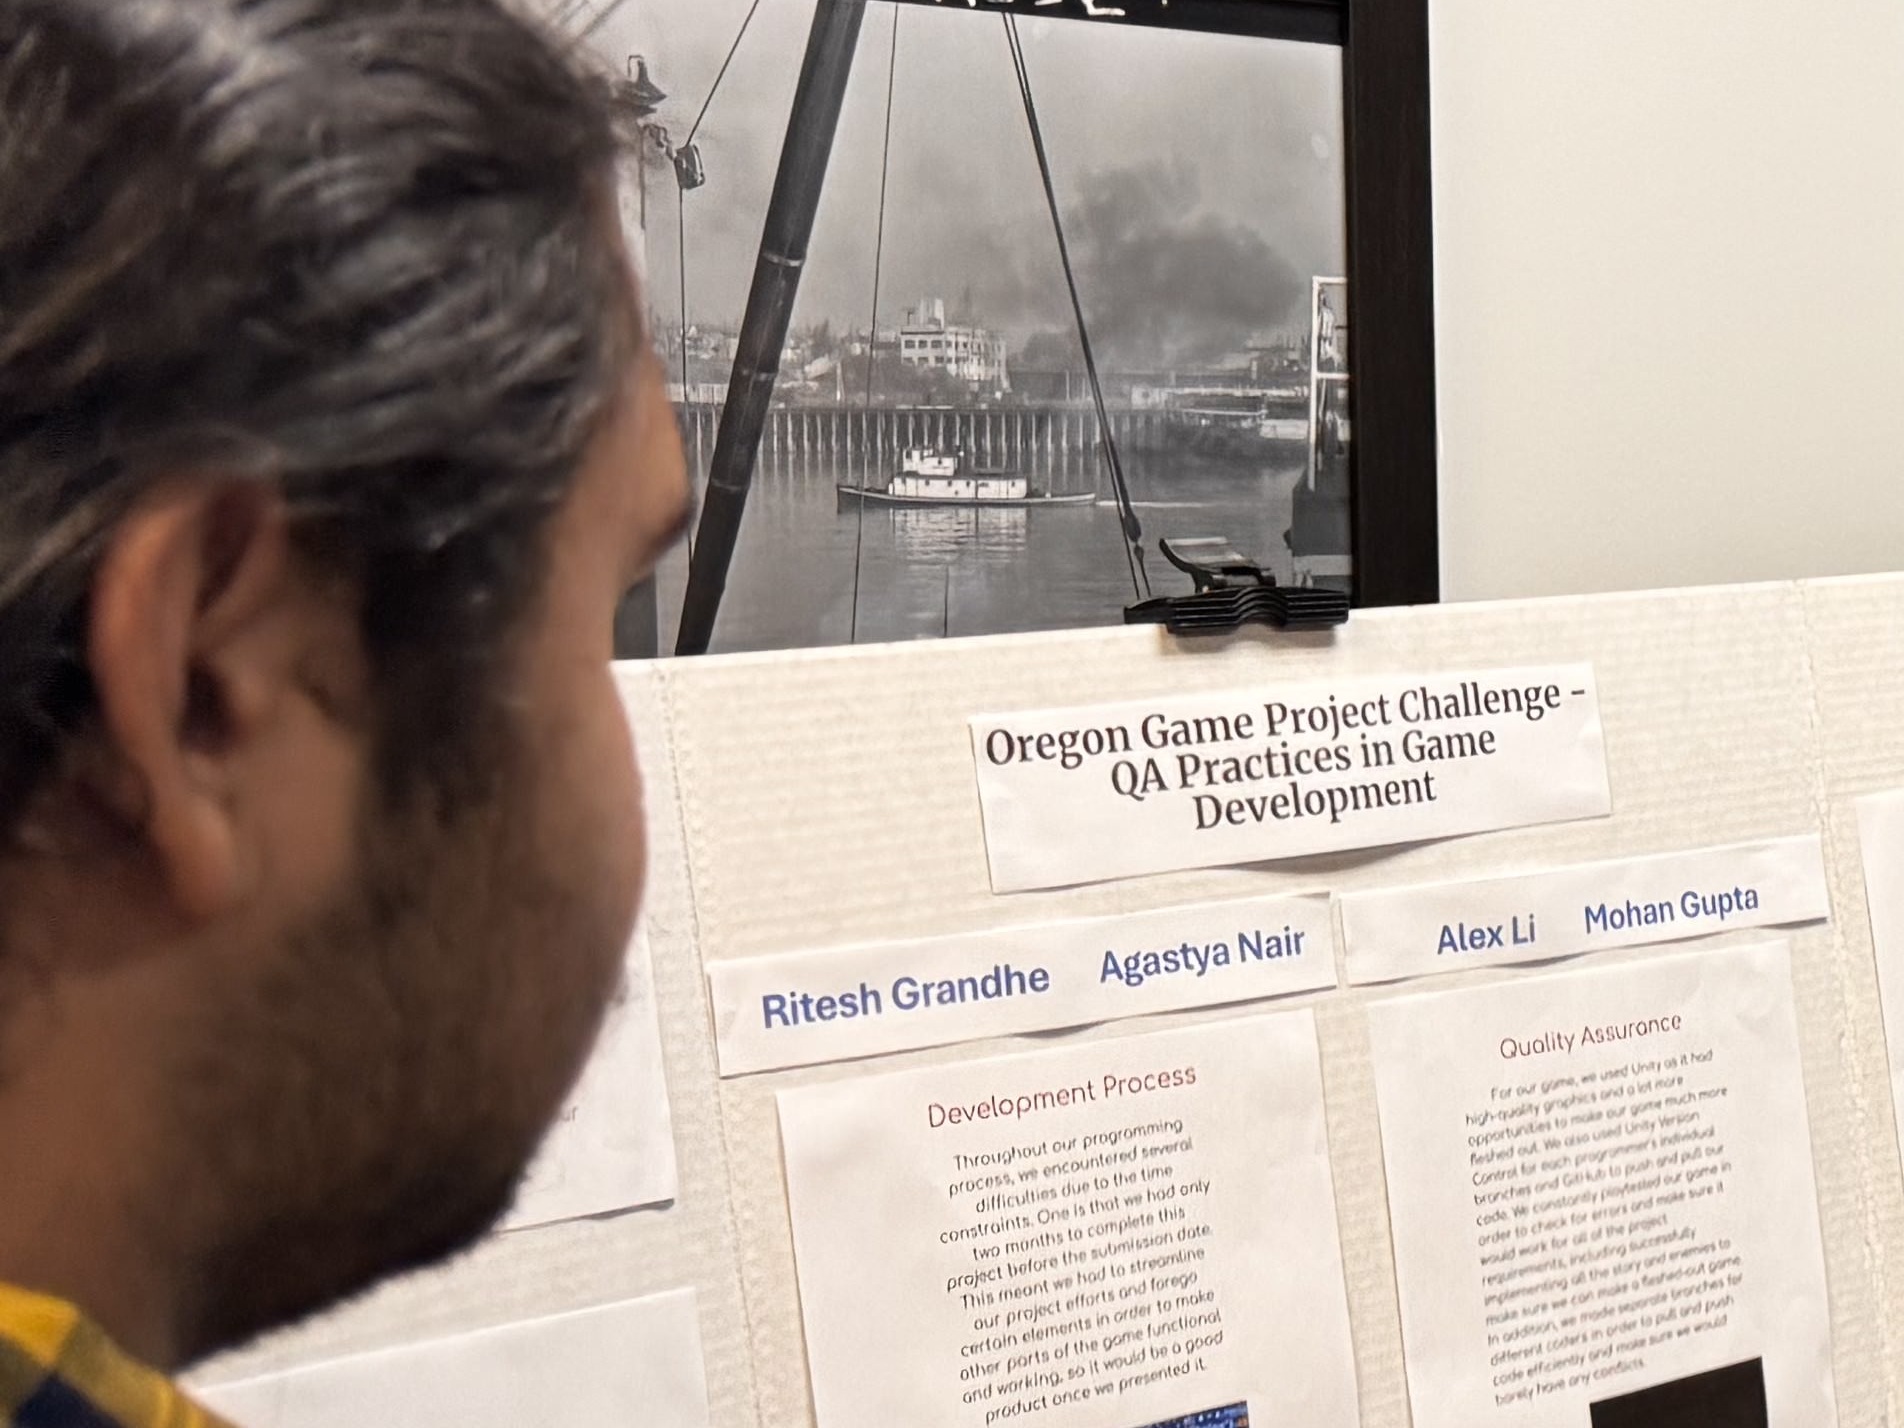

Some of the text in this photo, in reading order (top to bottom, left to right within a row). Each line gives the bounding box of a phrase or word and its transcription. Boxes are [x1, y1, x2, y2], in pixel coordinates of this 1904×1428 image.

[985, 725, 1133, 770] Oregon
[1140, 712, 1254, 749] Game
[1263, 693, 1392, 741] Project
[1398, 680, 1561, 723] Challenge
[1110, 729, 1496, 802] QA Practices in Game
[1191, 770, 1437, 830] Development
[1436, 912, 1536, 956] Alex Li
[1583, 886, 1759, 935] Mohan Gupta
[1099, 924, 1305, 988] Agastya Nair
[761, 963, 1050, 1029] Ritesh Grandhe
[1499, 1014, 1682, 1060] Quality Assurance
[927, 1066, 1197, 1129] Development Process
[948, 1135, 1193, 1200] process, we encountered several
[952, 1118, 1184, 1172] Throughout our programming
[938, 1178, 1211, 1245] constraints. One is that we had only
[974, 1165, 1174, 1214] difficulties due to the time
[945, 1264, 1003, 1294] project
[1005, 1255, 1059, 1279] before
[1061, 1249, 1087, 1267] the
[1090, 1231, 1174, 1260] submission
[971, 1204, 1186, 1262] two months to complete this
[958, 1247, 1206, 1311] This meant we had to streamline
[972, 1270, 1198, 1331] our project efforts and forego
[958, 1307, 1222, 1382] other parts of the game functional
[959, 1288, 1215, 1358] certain elements in order to make
[961, 1381, 993, 1404] and
[996, 1370, 1064, 1396] working,
[1066, 1364, 1086, 1381] so
[1088, 1358, 1100, 1376] it
[1102, 1346, 1147, 1372] would
[1148, 1344, 1169, 1361] be
[1184, 1328, 1224, 1356] good
[984, 1394, 1048, 1428] product
[1051, 1386, 1091, 1407] once
[1093, 1380, 1115, 1396] we
[1117, 1358, 1191, 1395] presented
